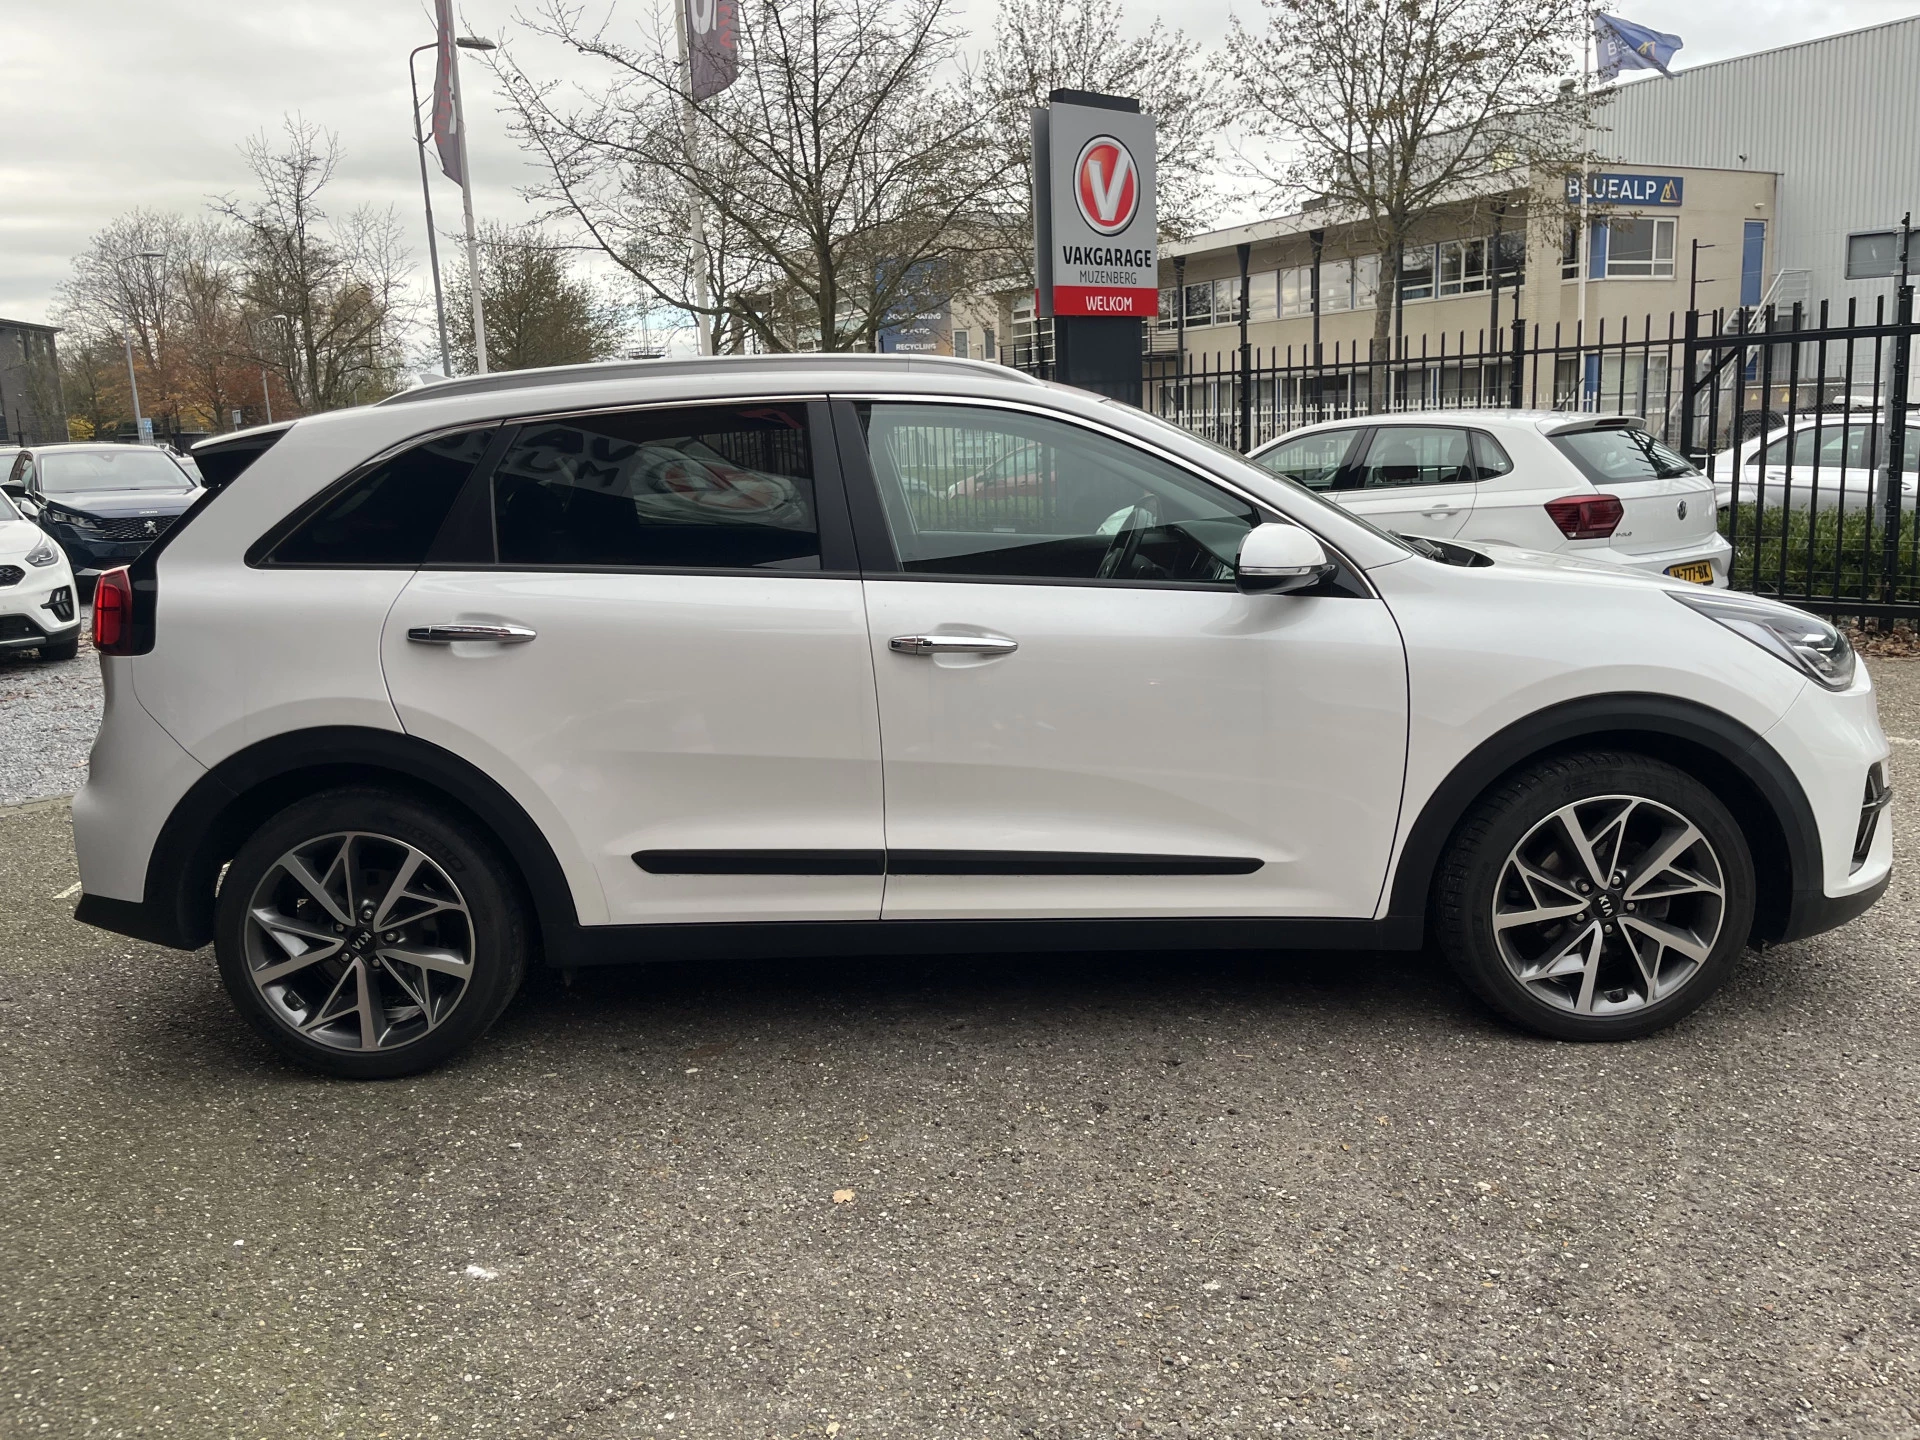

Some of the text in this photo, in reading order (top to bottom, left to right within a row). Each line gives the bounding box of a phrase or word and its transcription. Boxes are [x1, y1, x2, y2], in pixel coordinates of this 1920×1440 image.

[1062, 245, 1152, 268] VAKGARAGE
[1079, 270, 1137, 285] MUZENBERG
[1085, 295, 1133, 312] WELKOM
[895, 343, 937, 351] RECYCLING
[1598, 894, 1613, 917] KIA
[351, 931, 372, 951] KIA
